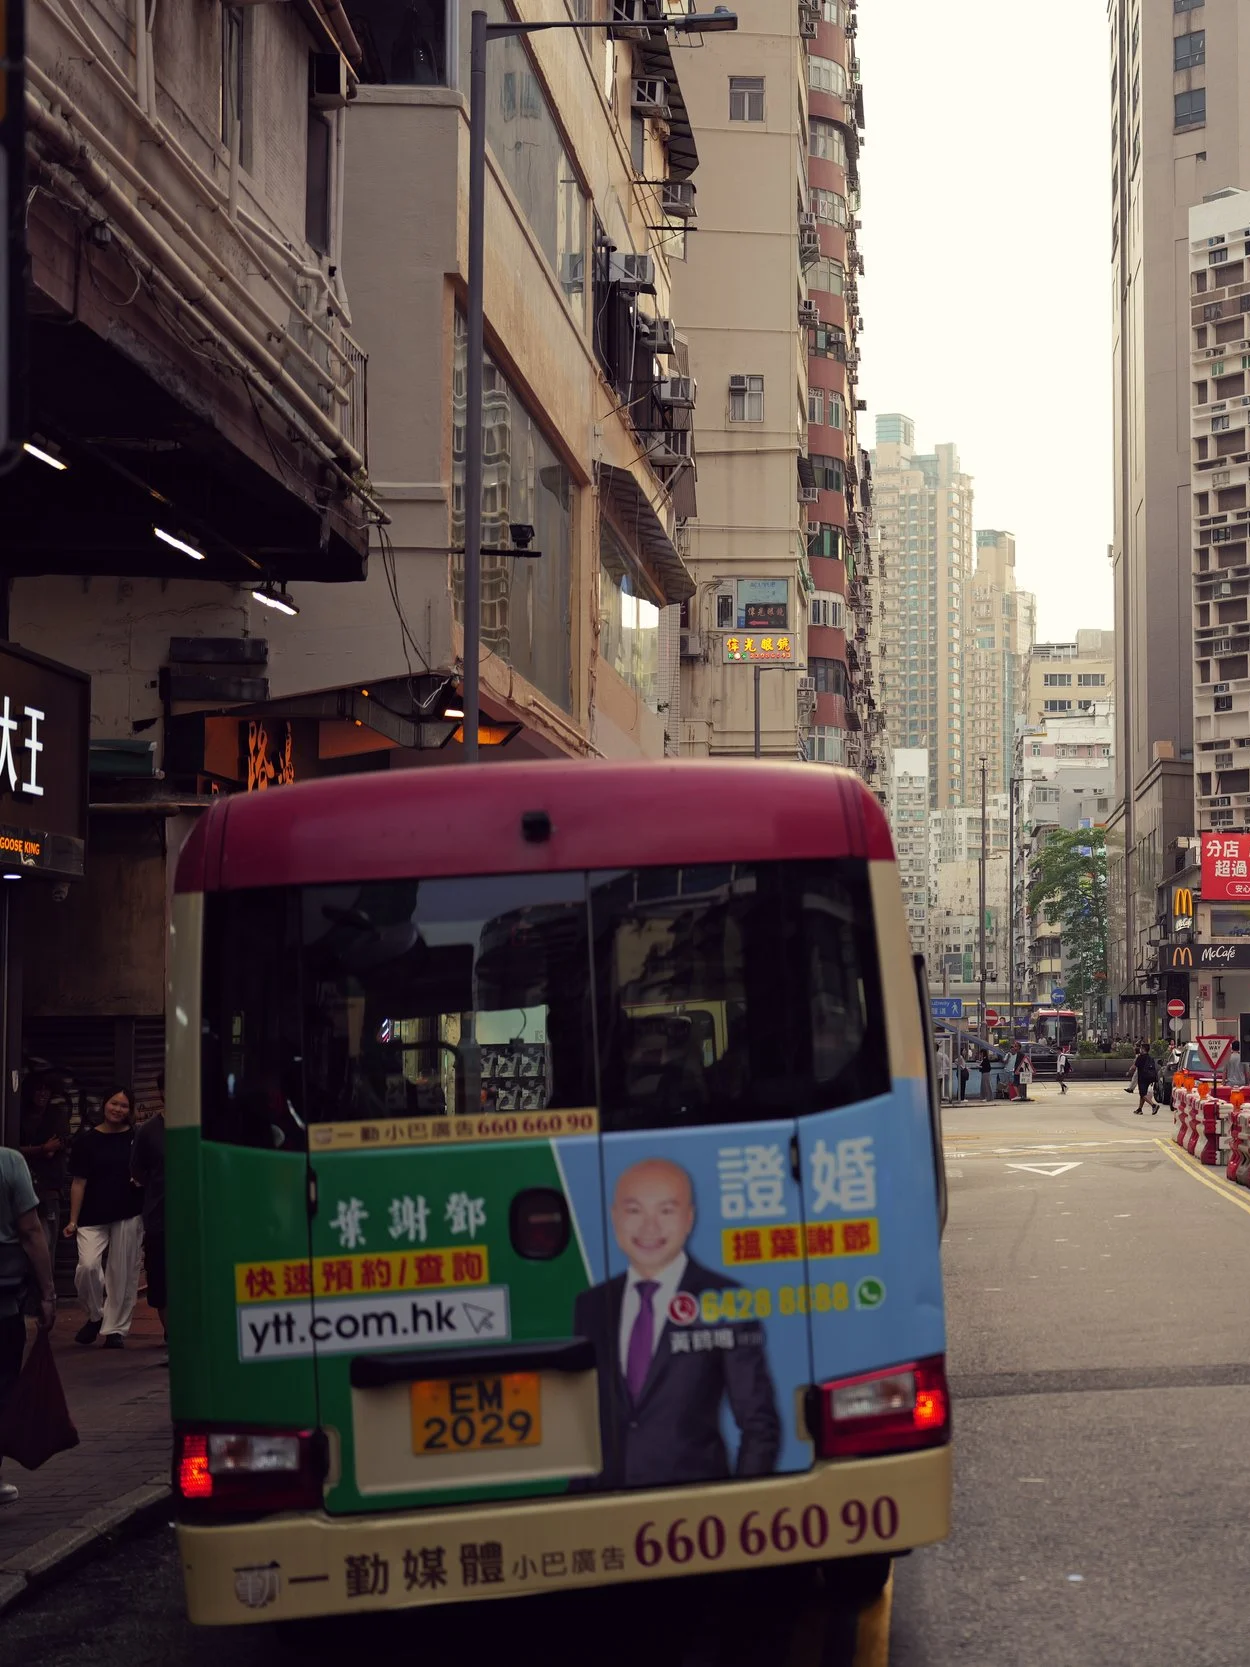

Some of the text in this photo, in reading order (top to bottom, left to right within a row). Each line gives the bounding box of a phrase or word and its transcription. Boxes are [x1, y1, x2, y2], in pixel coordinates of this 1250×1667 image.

[726, 637, 791, 652] 偉光眼鏡
[0, 696, 44, 797] 大王
[0, 836, 40, 855] GOOSE KING
[1206, 840, 1239, 857] 分店
[1215, 860, 1247, 877] 超過
[1201, 945, 1236, 962] McCafé
[477, 1118, 518, 1136] 660
[522, 1116, 562, 1134] 660
[566, 1113, 594, 1131] 90
[716, 1136, 877, 1219] 證婚
[329, 1192, 486, 1249] 葉謝鄧
[700, 1283, 848, 1323] 6428 8888
[248, 1300, 457, 1355] ytt.com.hk
[449, 1379, 504, 1415] EM
[423, 1410, 533, 1450] 2029
[288, 1541, 506, 1598] 一勤媒體
[511, 1546, 627, 1581] 小巴廣告
[634, 1514, 727, 1569] 660
[737, 1505, 830, 1557] 660
[840, 1495, 901, 1545] 90
